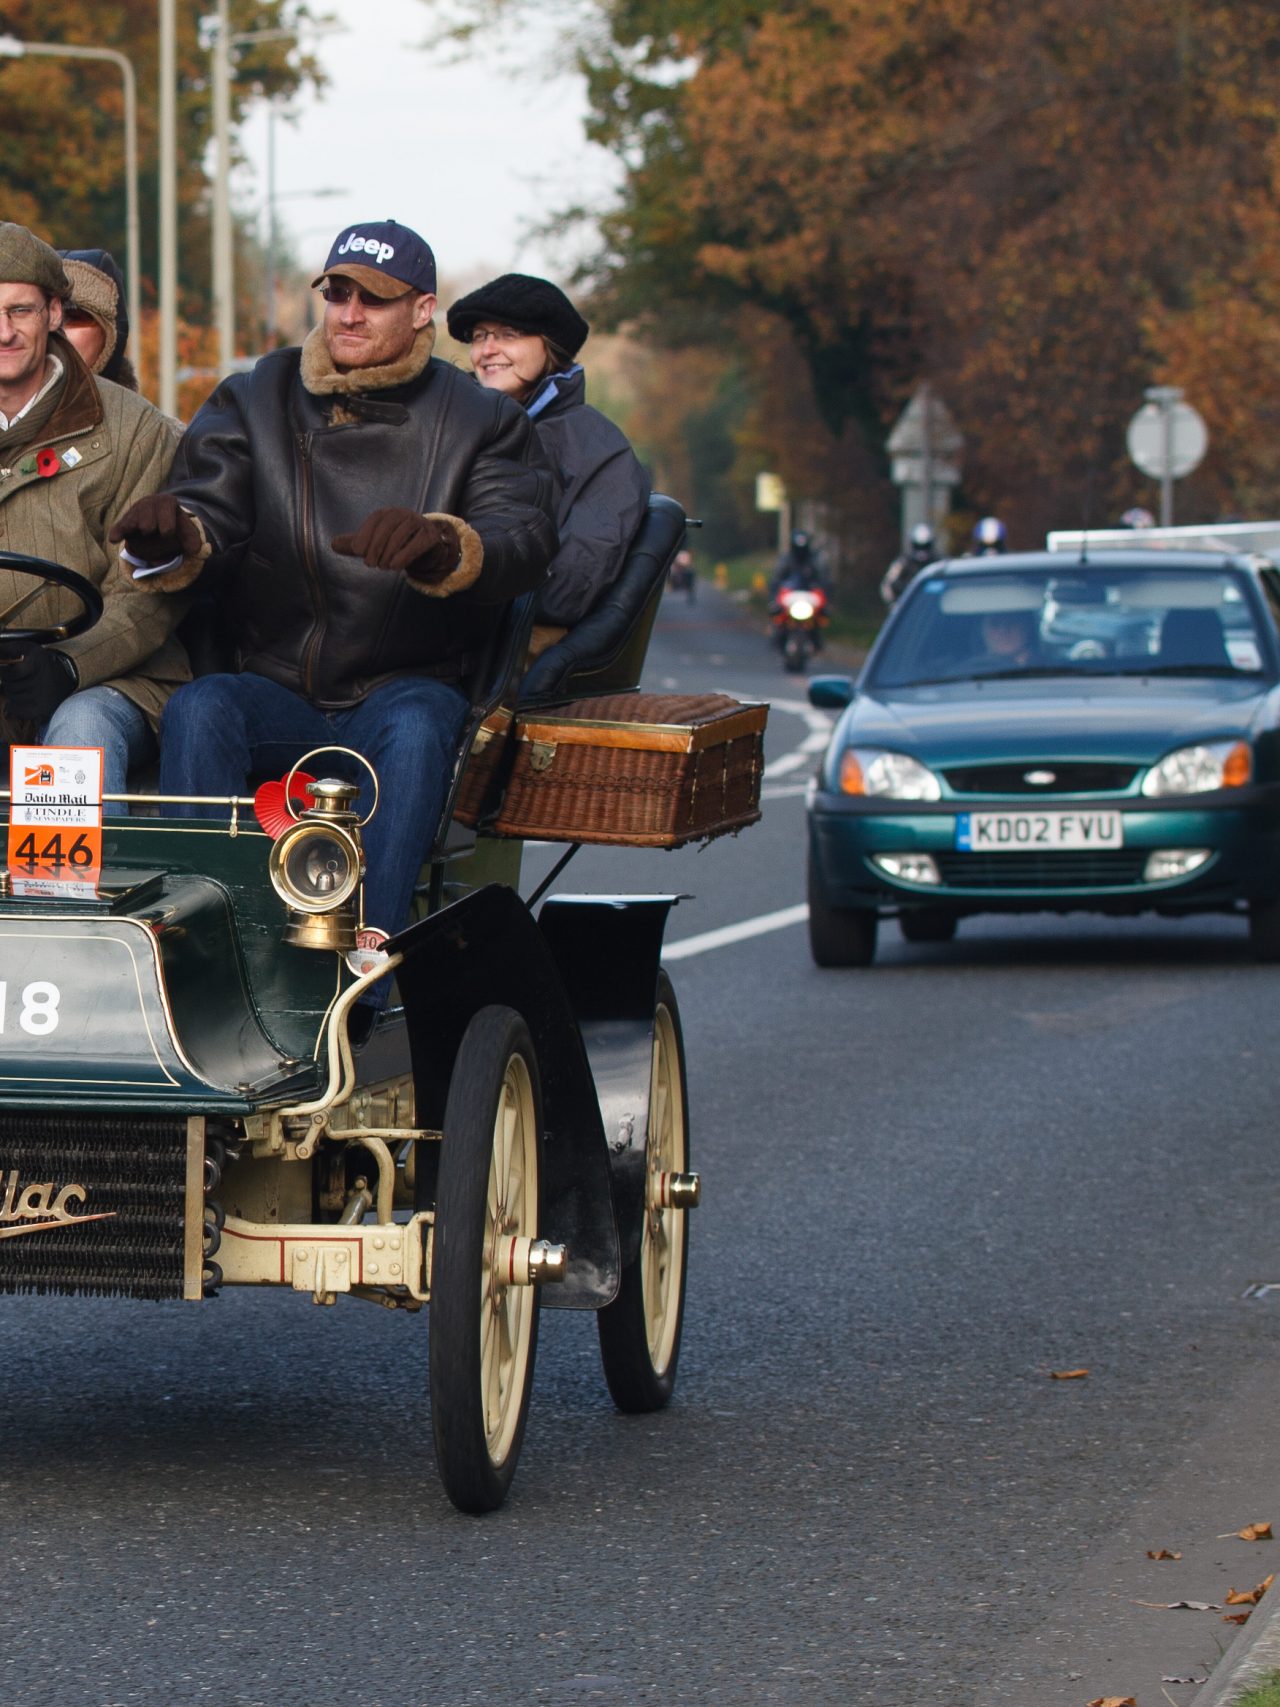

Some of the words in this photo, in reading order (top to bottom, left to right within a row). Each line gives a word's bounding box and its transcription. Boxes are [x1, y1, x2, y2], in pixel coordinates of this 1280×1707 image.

[338, 233, 394, 264] Jeep
[25, 793, 56, 804] Daily
[59, 794, 87, 805] Mail
[33, 808, 86, 817] TINDLE
[978, 816, 1049, 842] KD02
[1060, 816, 1114, 841] FVU
[15, 832, 93, 867] 446
